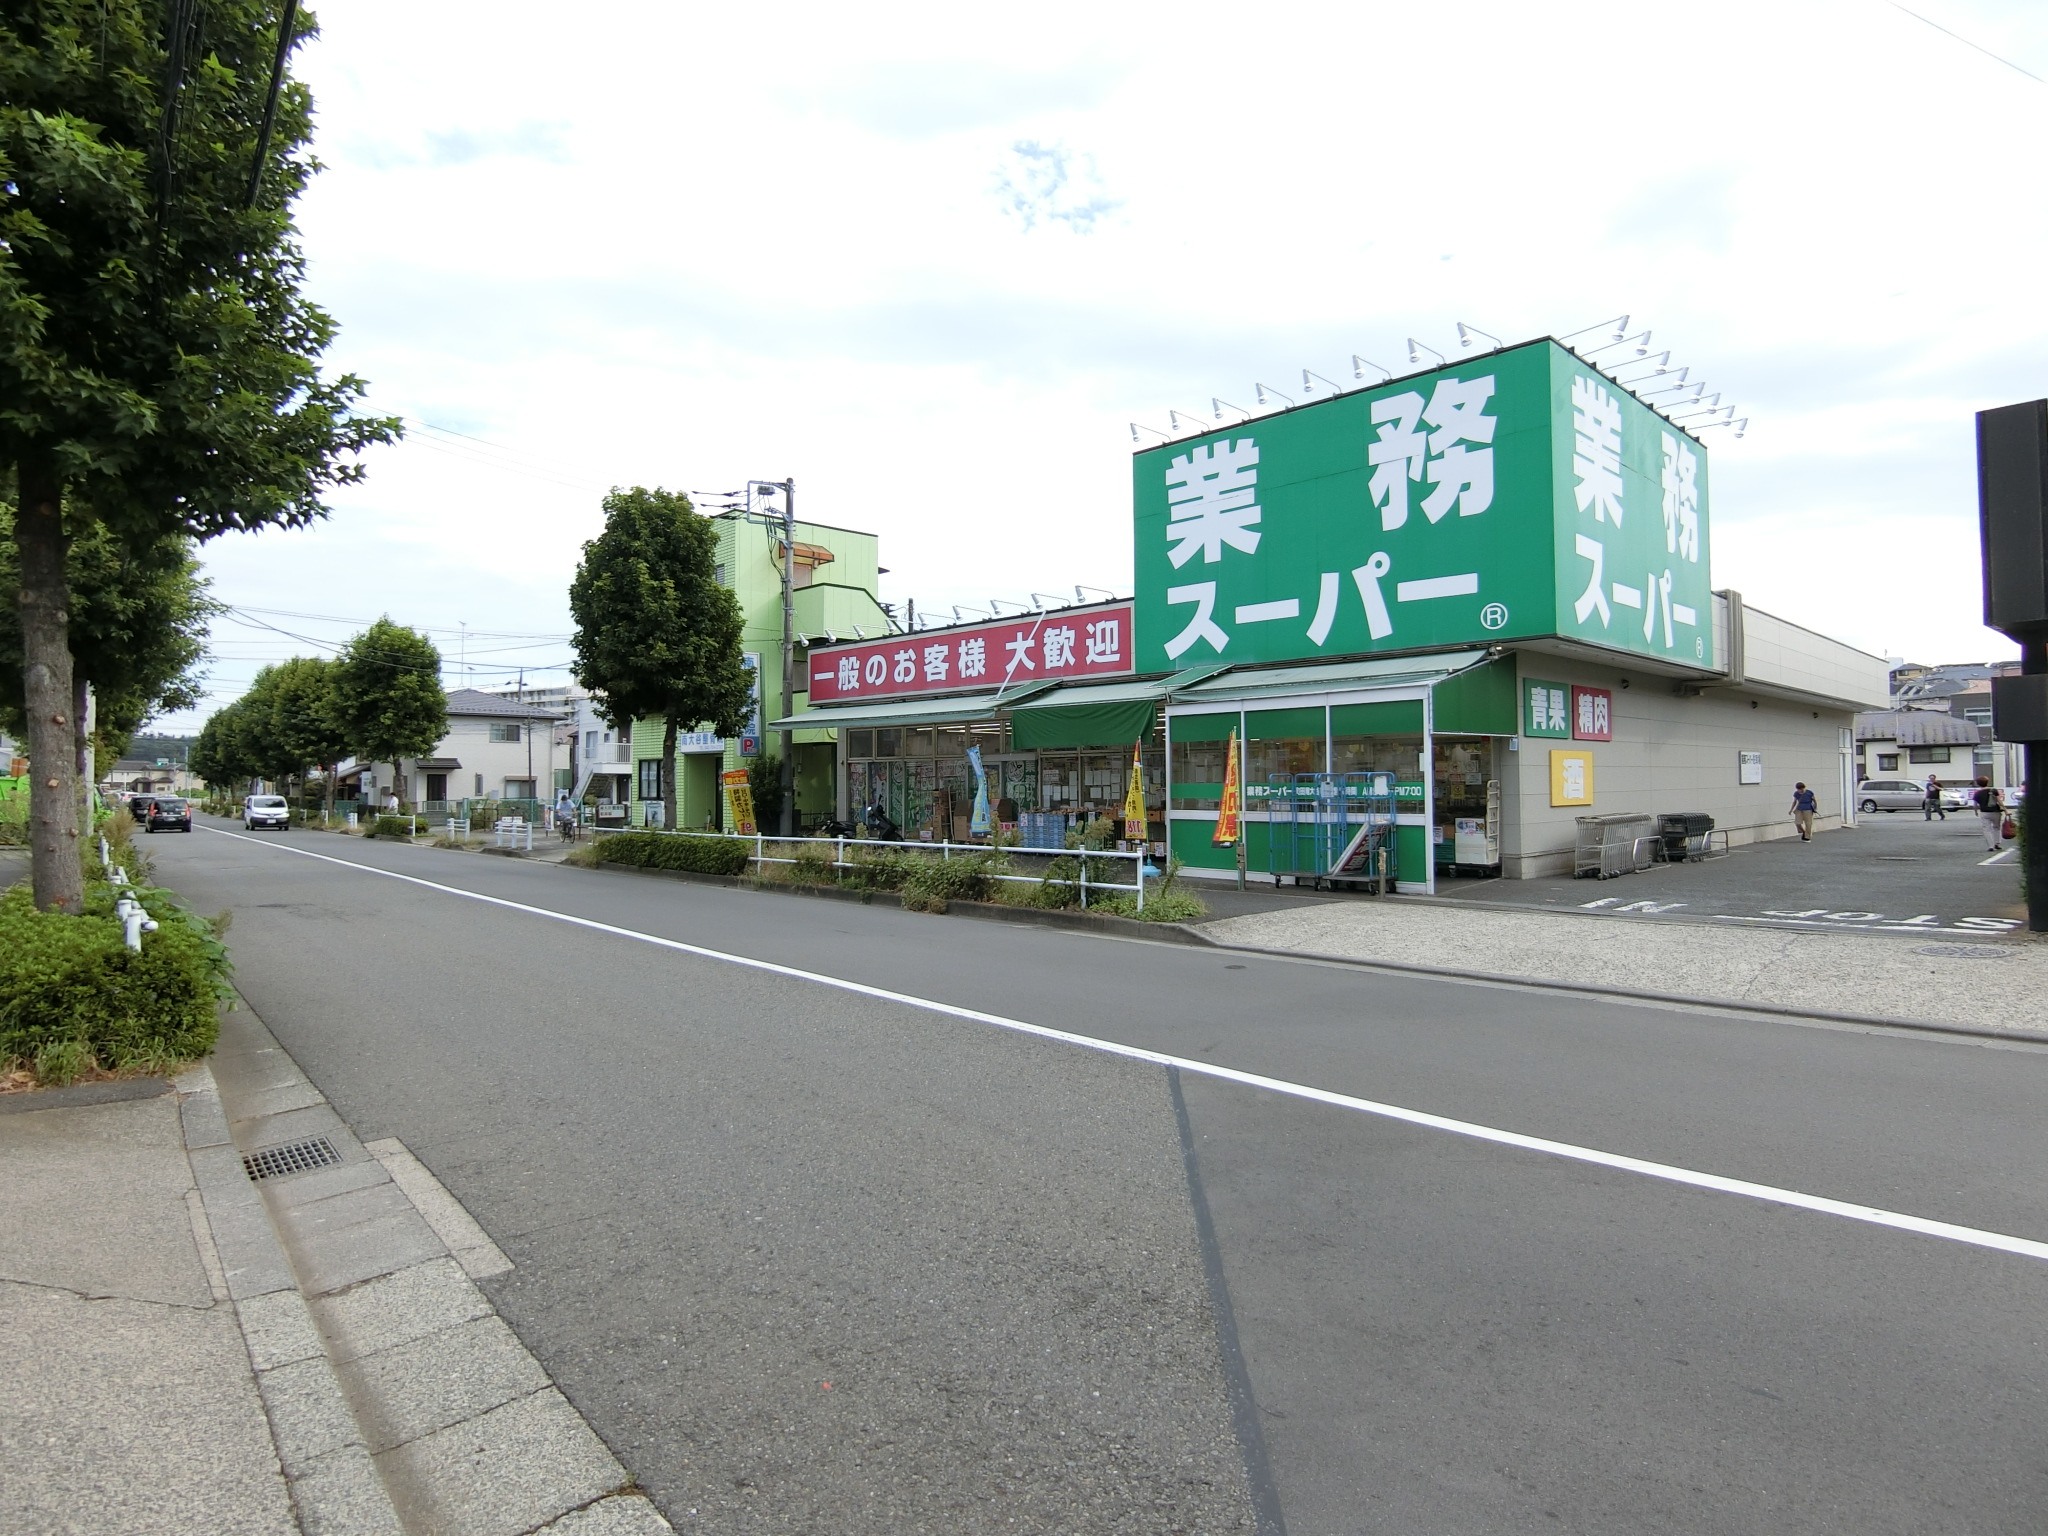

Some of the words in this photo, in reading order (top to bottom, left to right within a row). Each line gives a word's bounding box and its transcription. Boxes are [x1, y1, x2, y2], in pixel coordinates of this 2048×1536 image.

[1165, 374, 1497, 570] 業務
[1571, 374, 1699, 563] 業務
[1163, 551, 1478, 661] スーパー
[1574, 534, 1697, 648] スーパー
[814, 637, 986, 691] 一般のお客様
[1005, 620, 1120, 673] 大歓迎
[1531, 687, 1566, 731] 青果
[1578, 693, 1609, 735] 精肉
[1247, 785, 1292, 797] 業務スーパー
[1562, 758, 1584, 799] 酒
[1760, 908, 2023, 930] STOP
